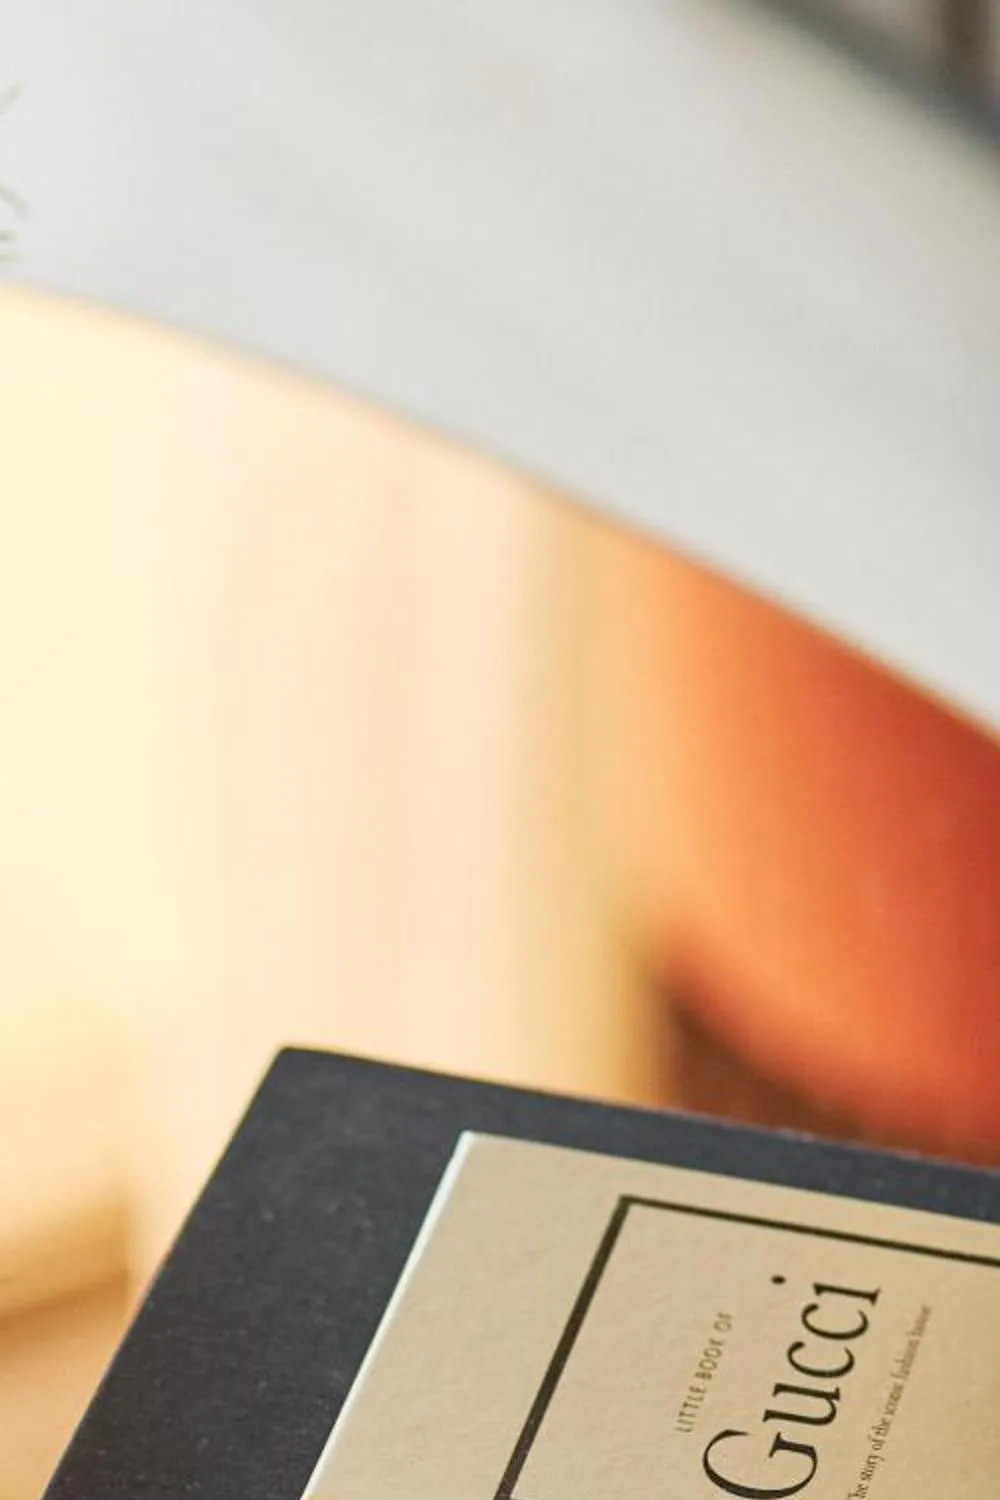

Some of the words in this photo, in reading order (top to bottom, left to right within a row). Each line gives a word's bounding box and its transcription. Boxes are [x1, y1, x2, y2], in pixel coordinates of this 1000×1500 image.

[673, 1384, 707, 1433] LITTLE
[694, 1337, 725, 1380] BOOK
[713, 1311, 733, 1332] OF
[703, 1275, 882, 1500] Gucci
[872, 1417, 892, 1437] the
[868, 1434, 886, 1451] of
[860, 1455, 885, 1482] story
